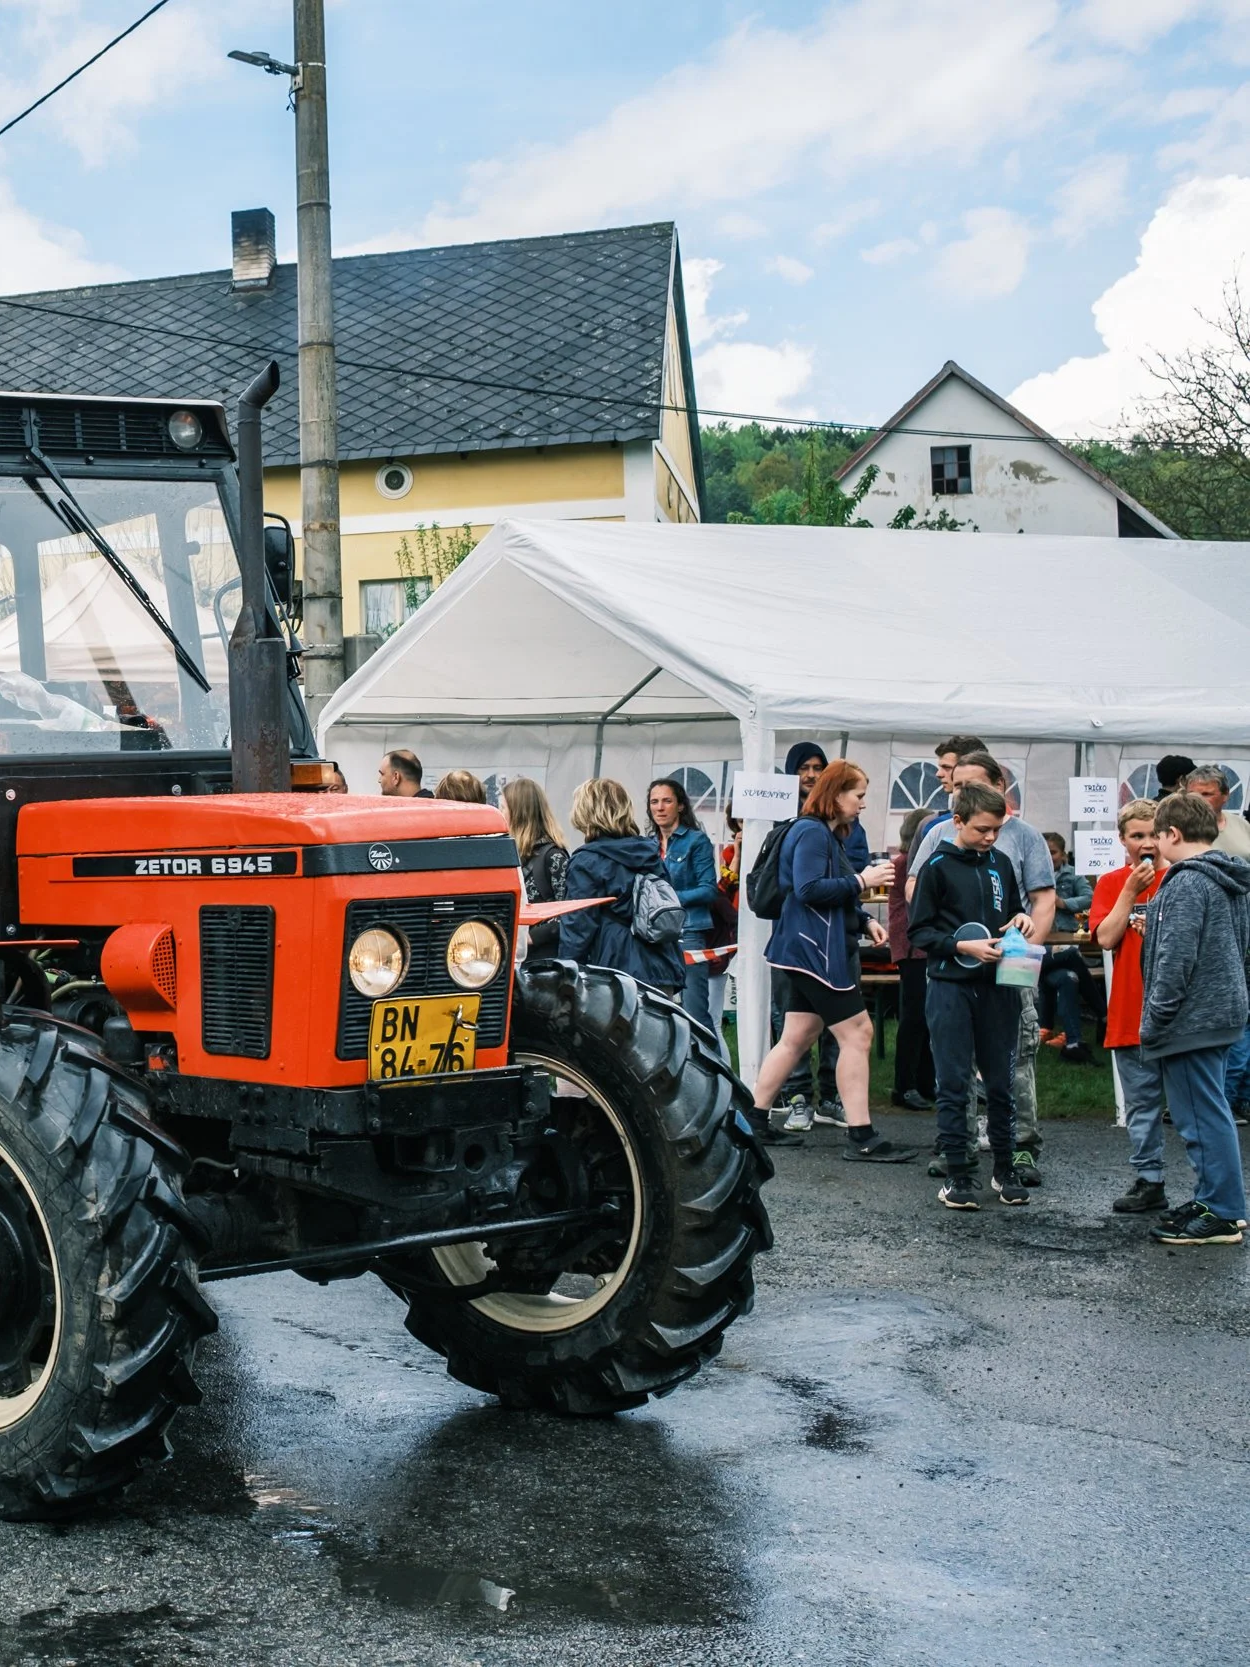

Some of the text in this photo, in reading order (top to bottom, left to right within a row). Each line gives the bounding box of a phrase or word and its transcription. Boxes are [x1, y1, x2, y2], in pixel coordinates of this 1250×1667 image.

[1084, 784, 1107, 792] TRIČKO
[1090, 837, 1113, 845] TRIČKO
[135, 856, 273, 875] ZETOR 6945
[381, 1005, 421, 1044] BN
[381, 1041, 465, 1079] 84-76
